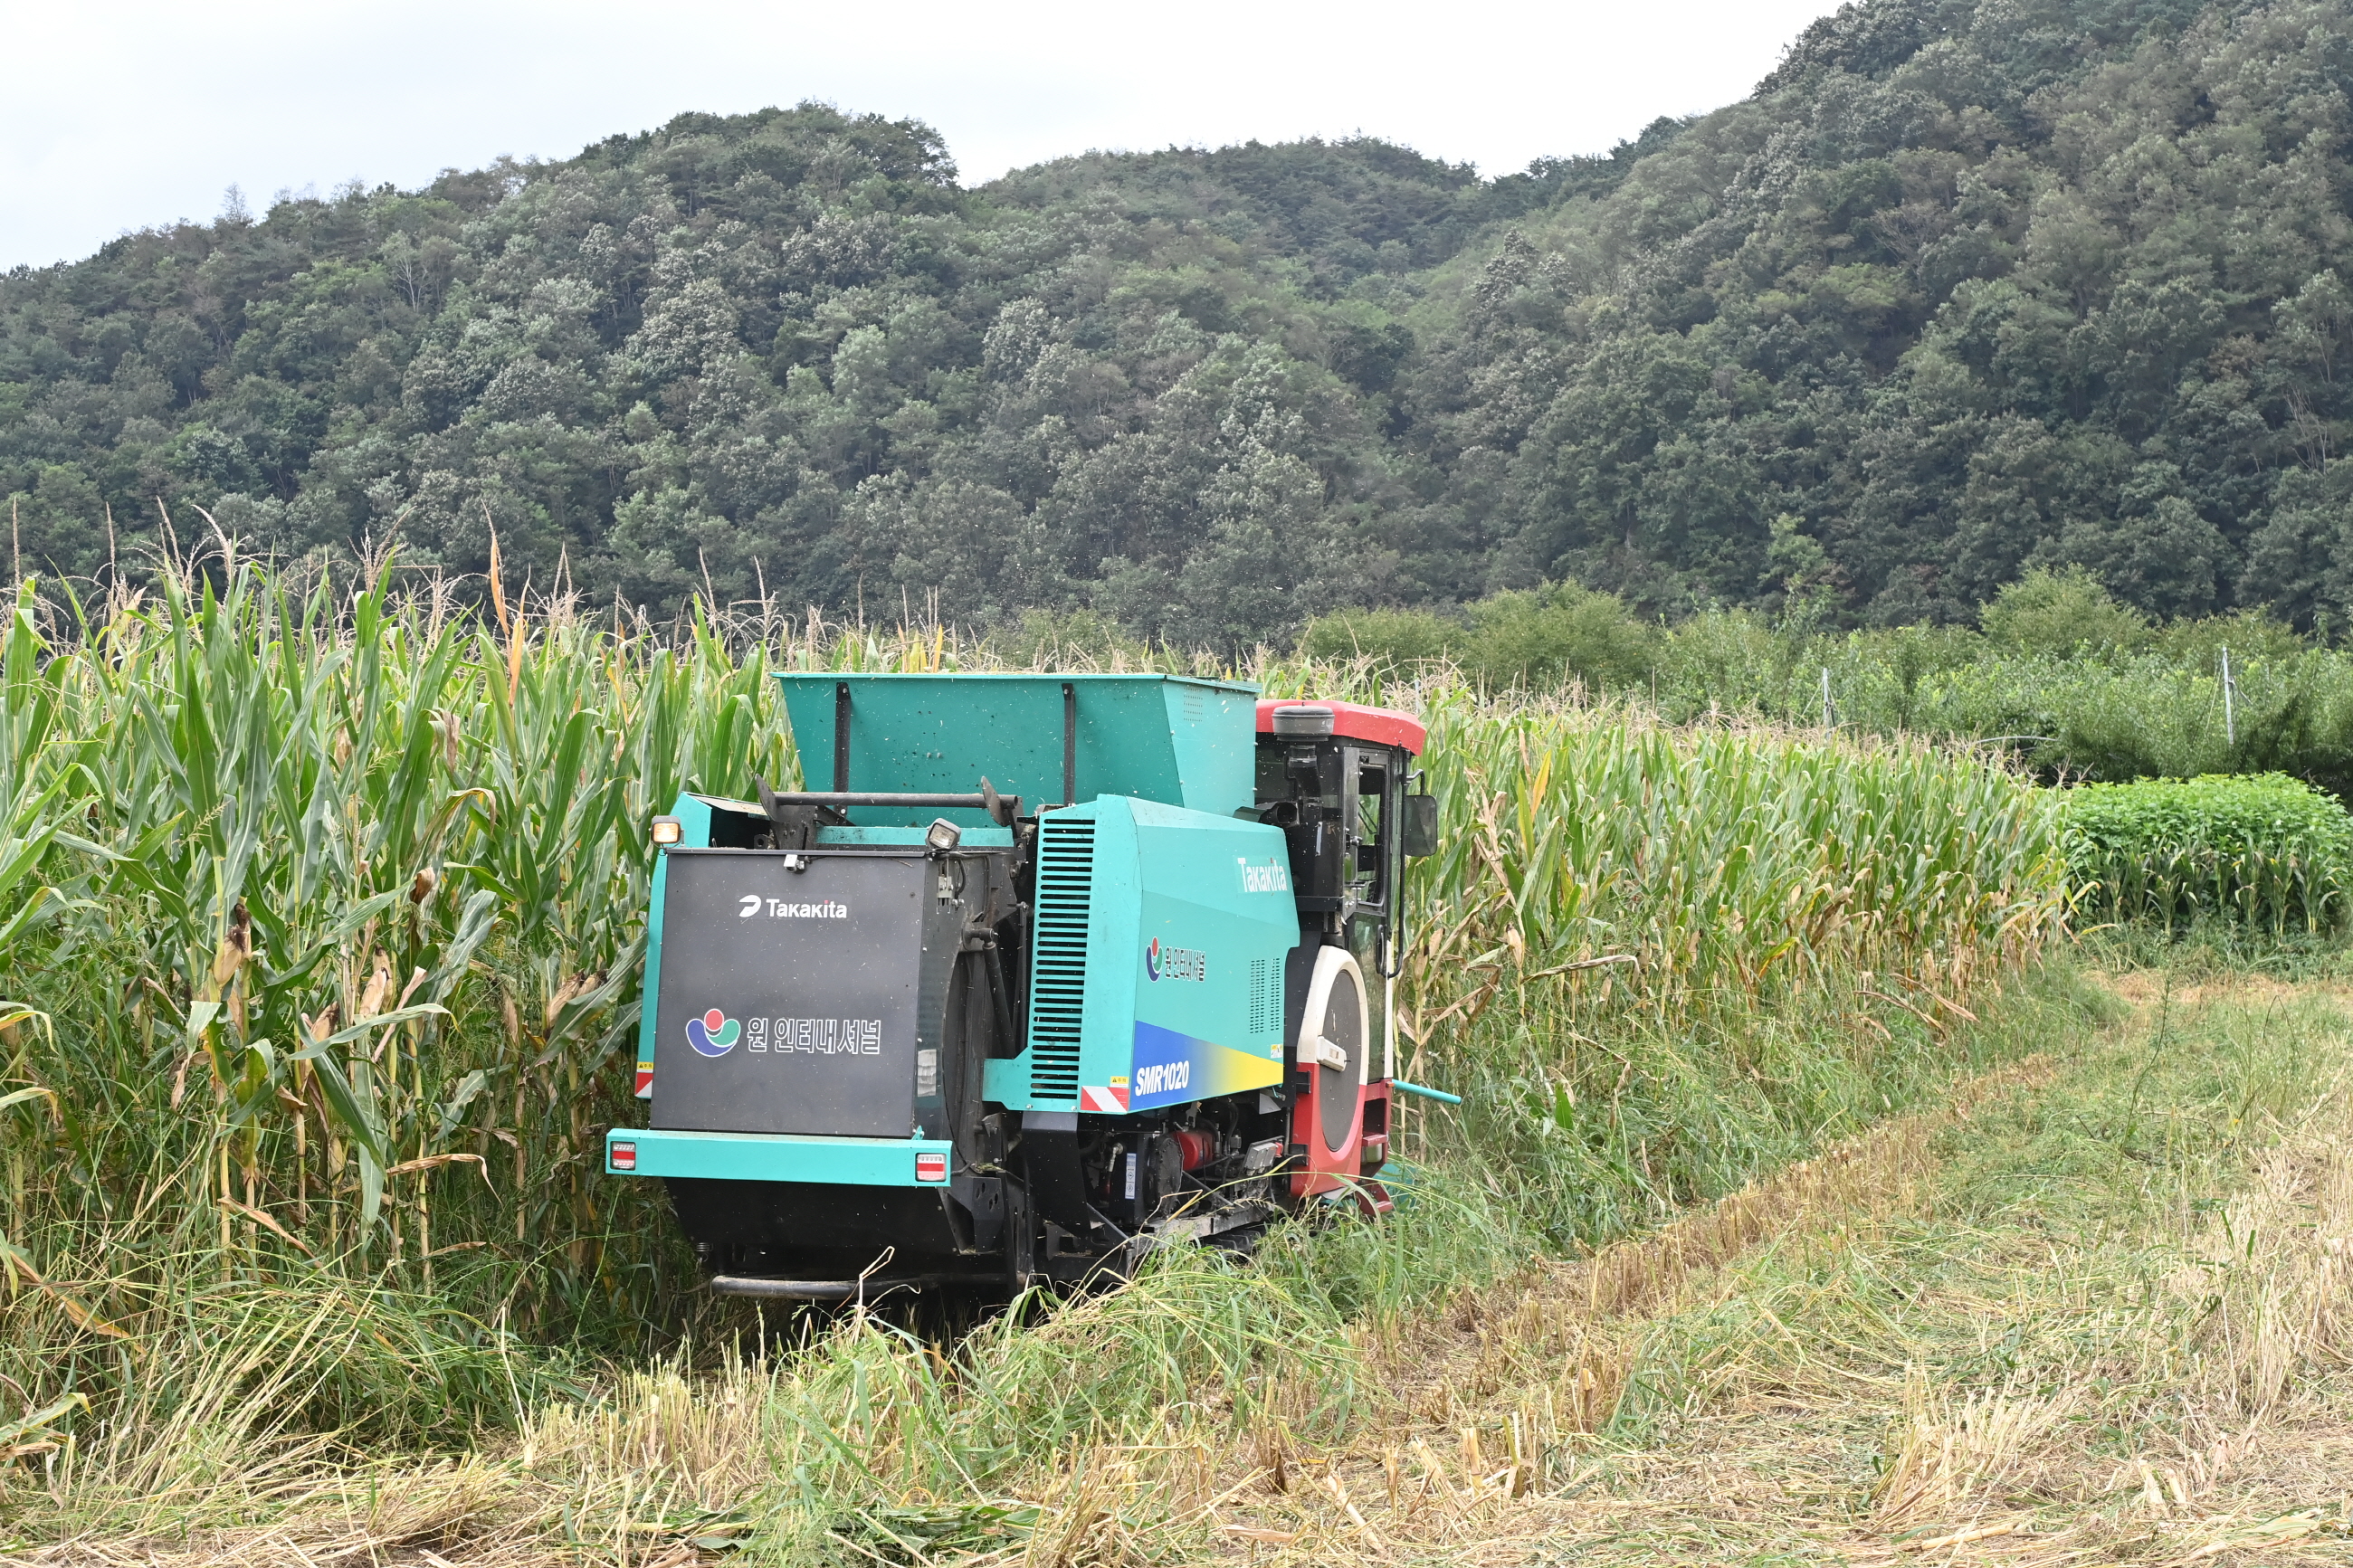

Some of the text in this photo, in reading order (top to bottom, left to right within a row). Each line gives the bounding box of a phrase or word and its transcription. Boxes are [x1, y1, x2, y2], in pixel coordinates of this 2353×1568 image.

[1237, 857, 1287, 892] Takakita
[766, 898, 847, 918] Takakita
[1165, 946, 1205, 983] 원 인터내셔널
[747, 1018, 881, 1055] 원 인터내셔널
[1135, 1060, 1190, 1097] SMR1020
